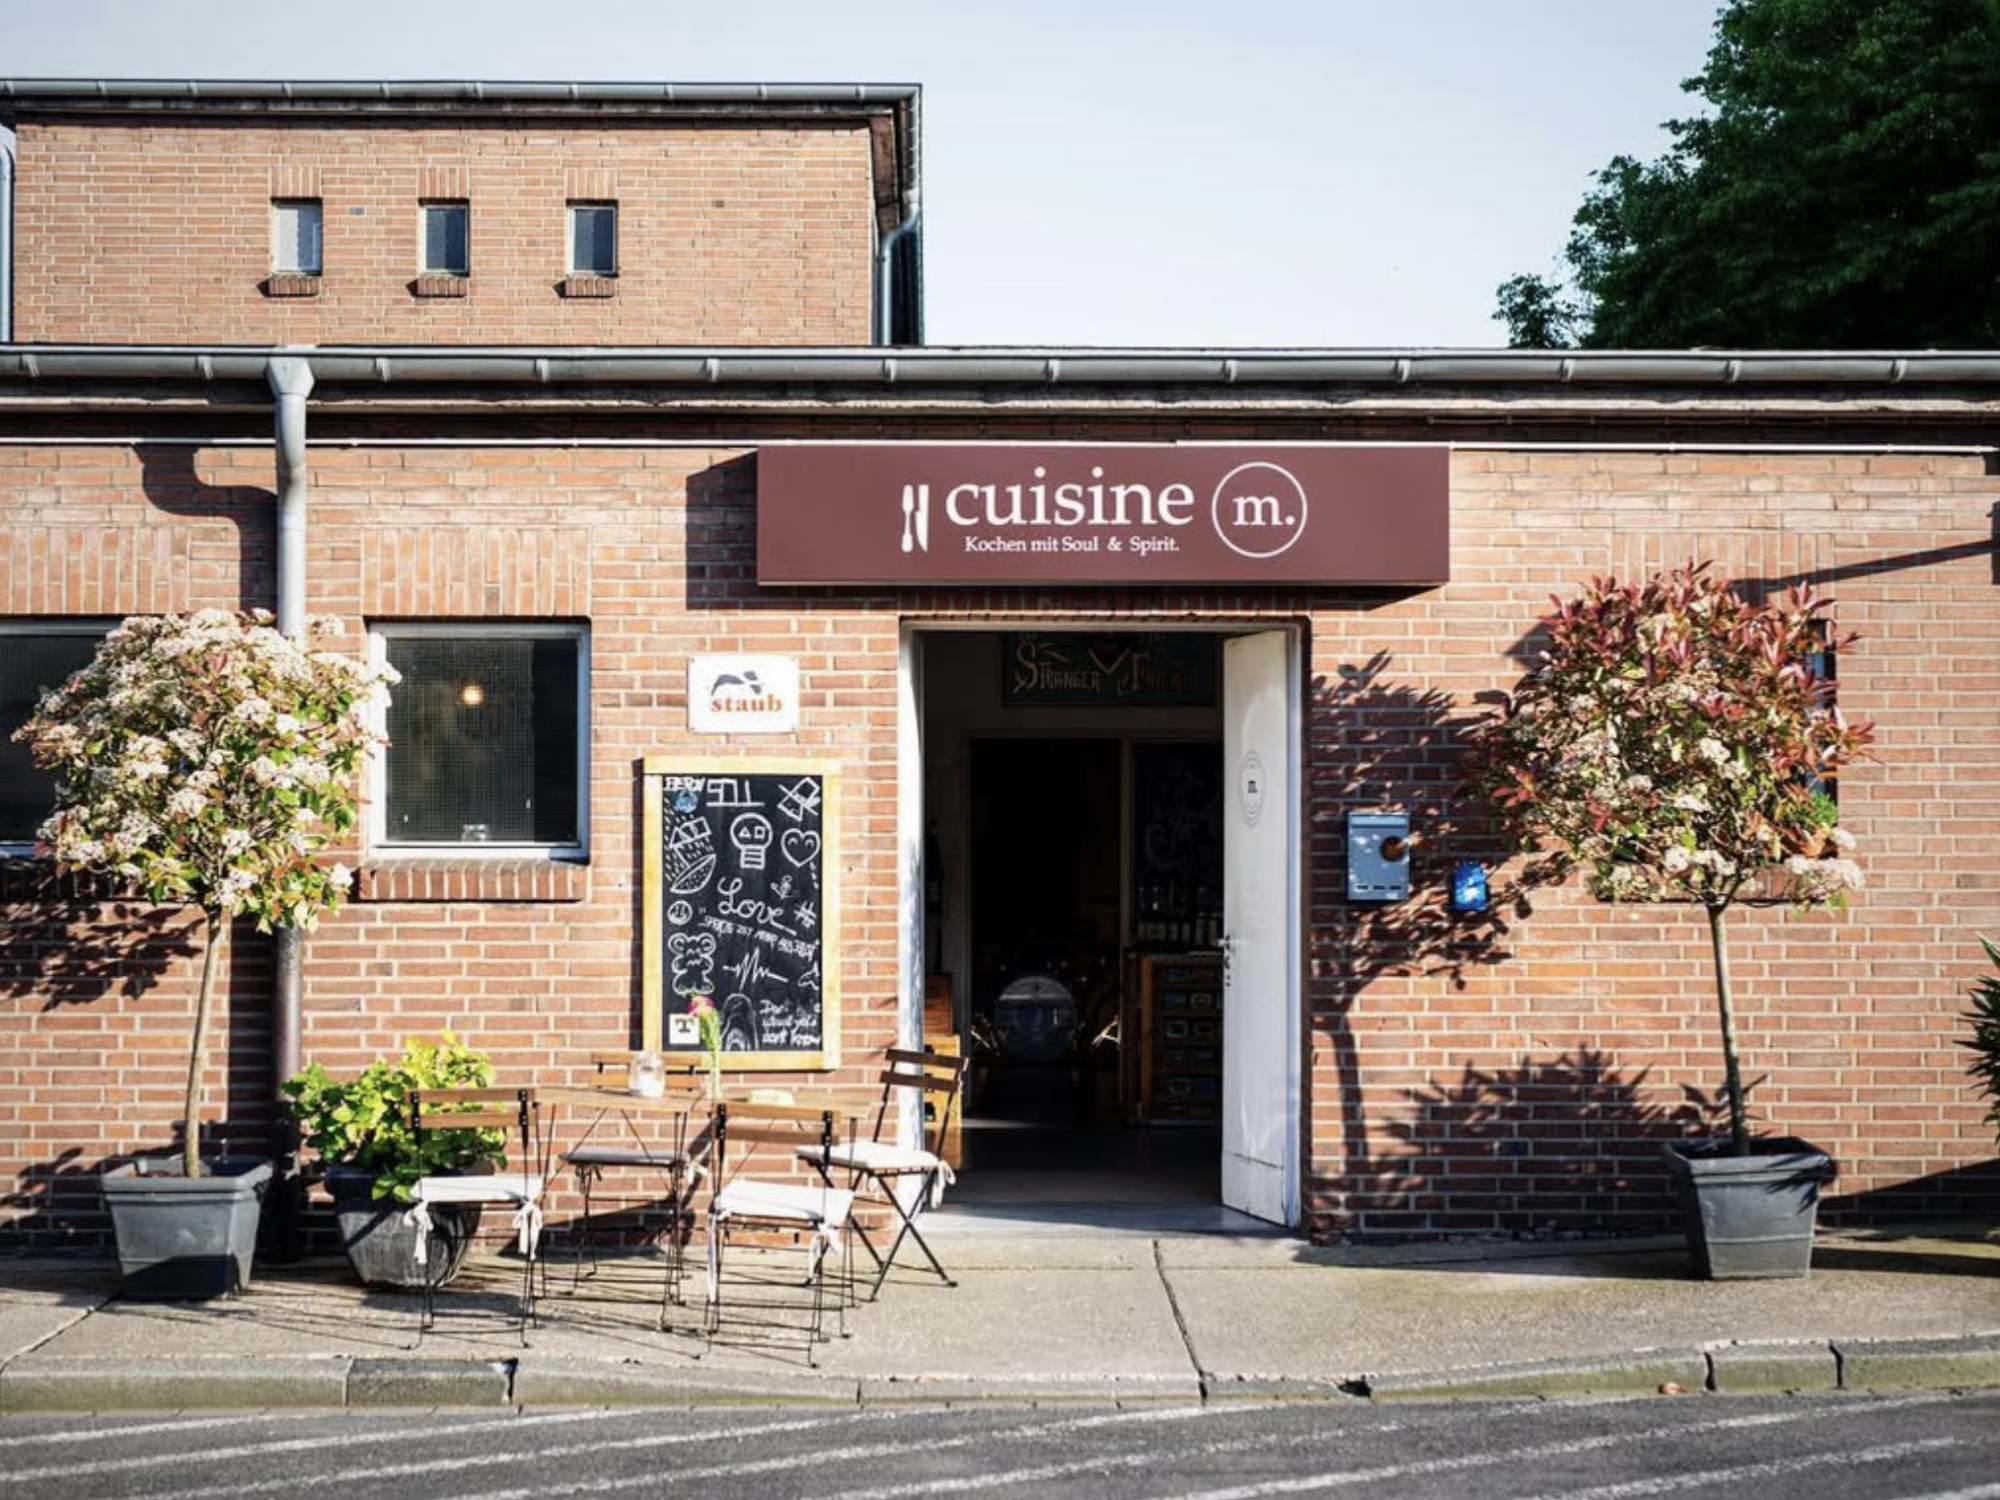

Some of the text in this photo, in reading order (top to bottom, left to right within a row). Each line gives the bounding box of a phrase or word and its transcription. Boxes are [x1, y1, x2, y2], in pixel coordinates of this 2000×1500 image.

[946, 466, 1297, 527] cuisine m.
[964, 536, 1180, 556] Kochen mit Soul & Spirit.
[711, 693, 783, 713] staub
[717, 876, 797, 937] Love
